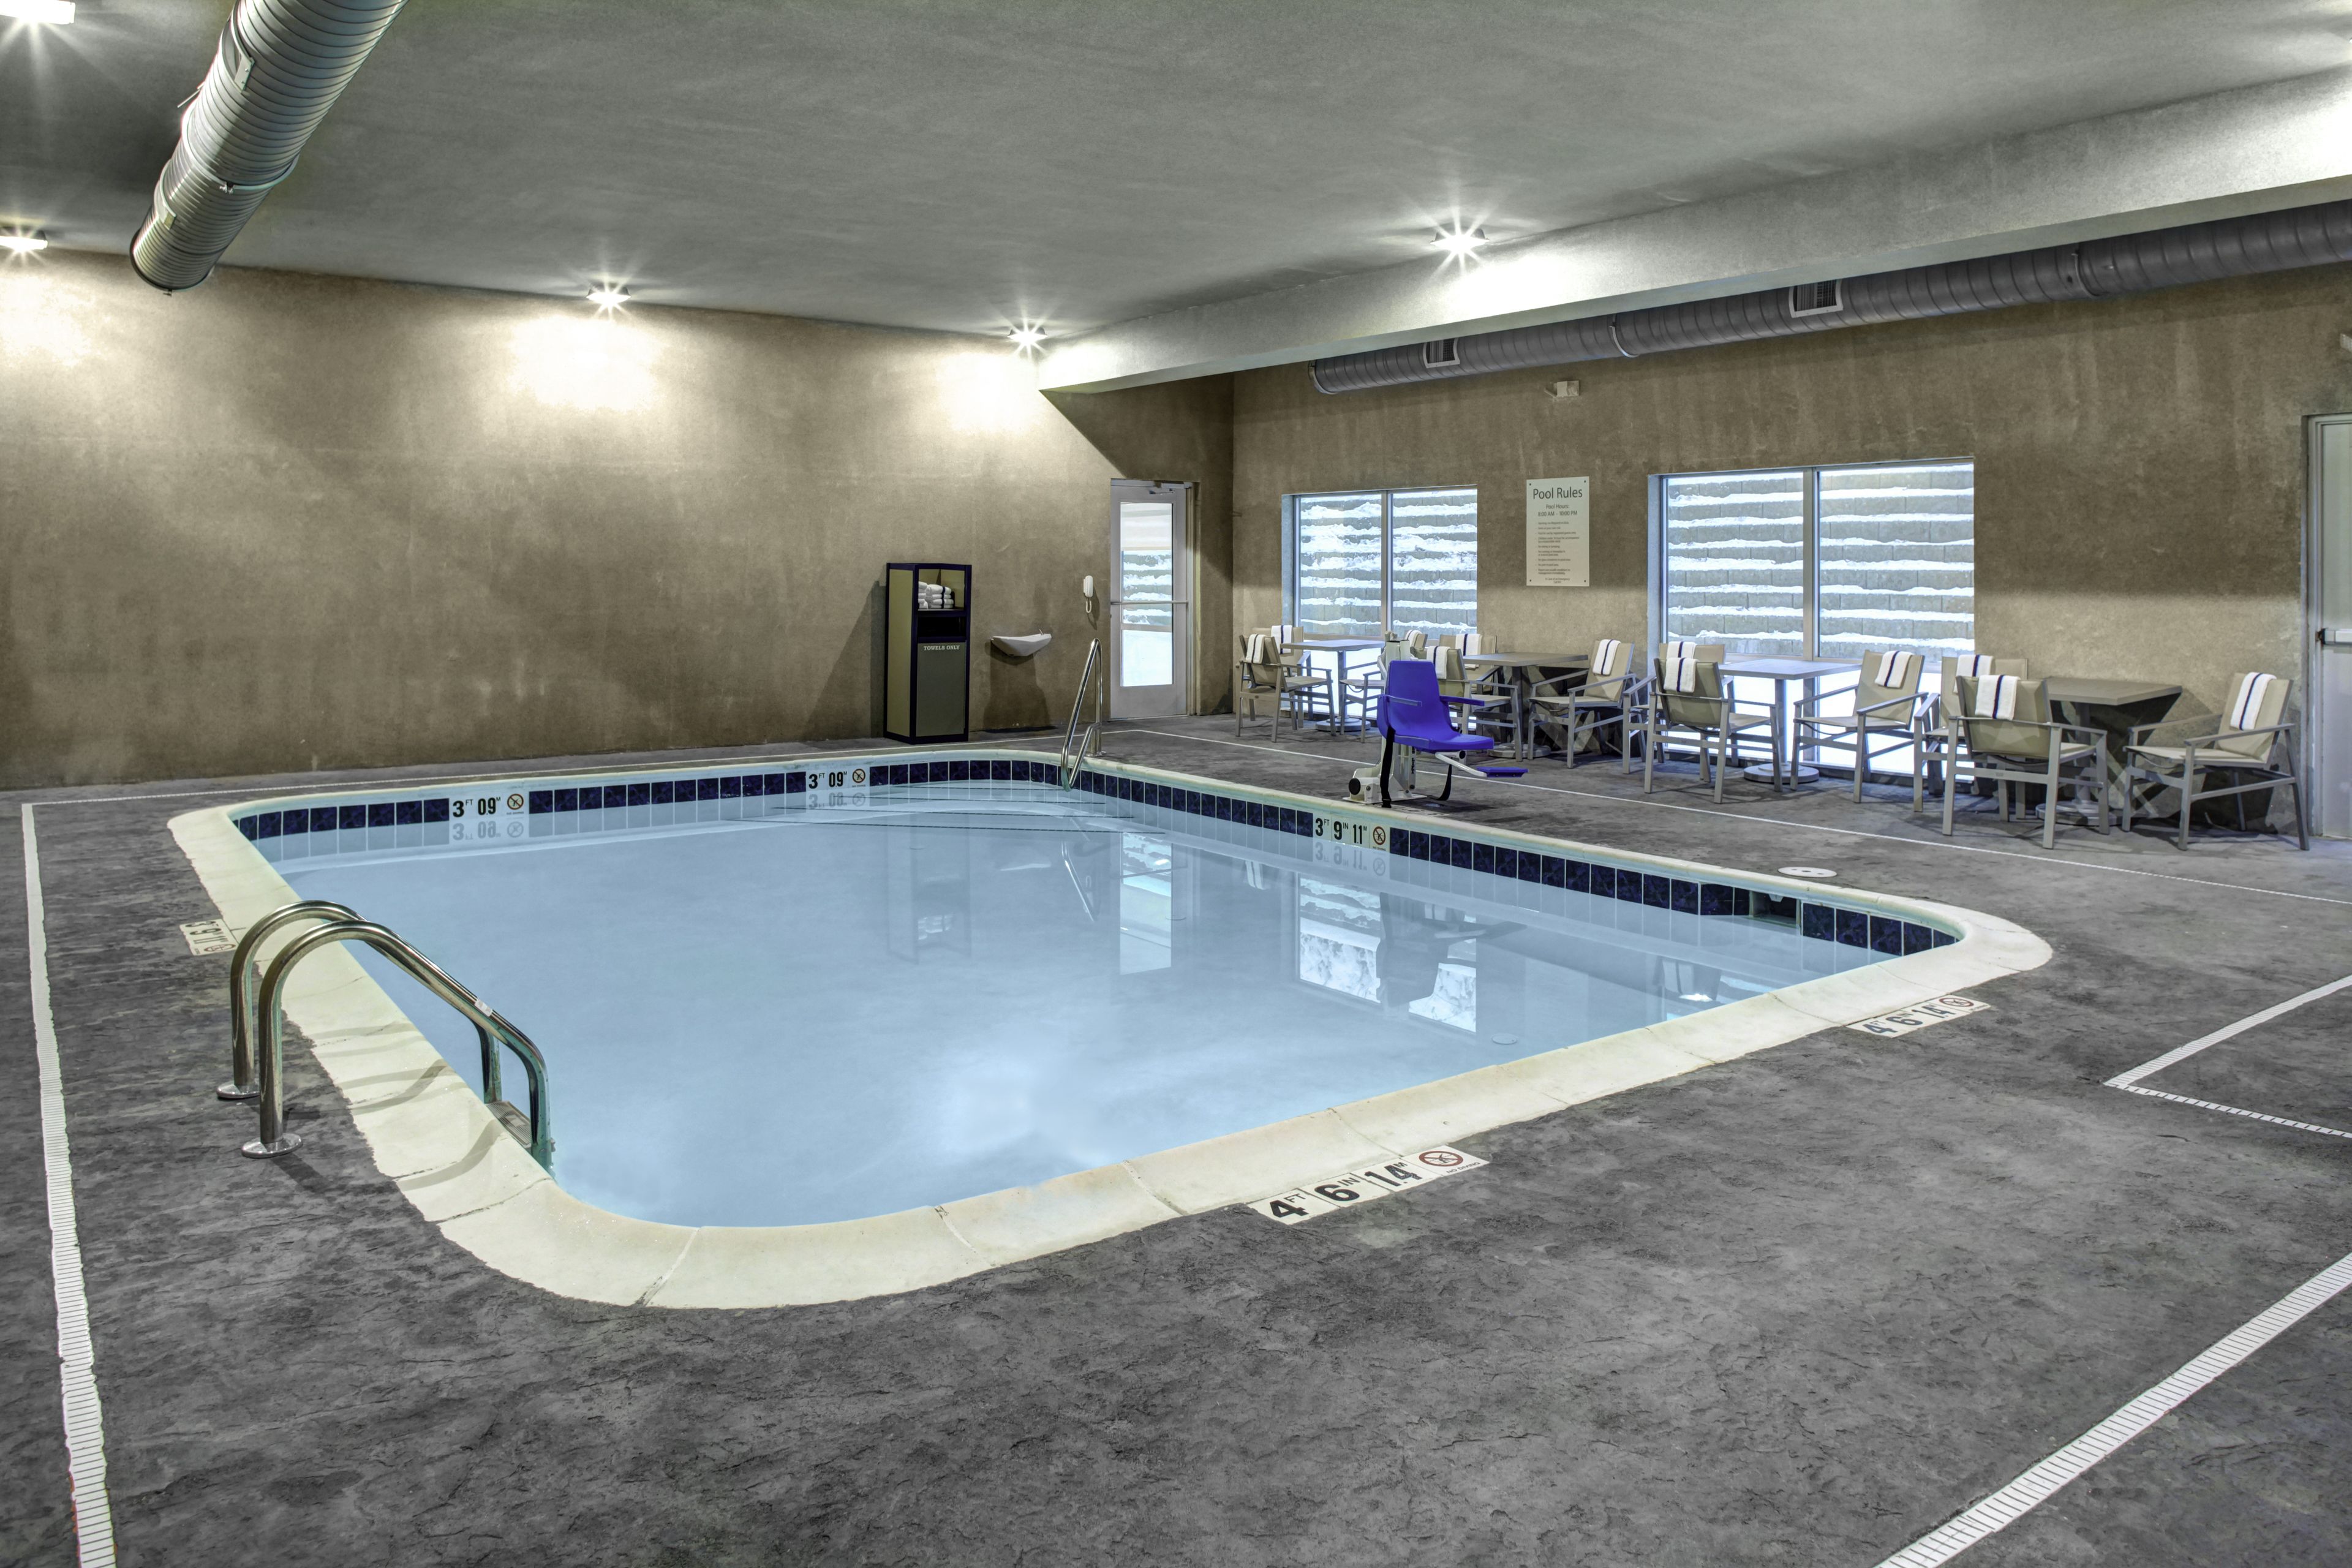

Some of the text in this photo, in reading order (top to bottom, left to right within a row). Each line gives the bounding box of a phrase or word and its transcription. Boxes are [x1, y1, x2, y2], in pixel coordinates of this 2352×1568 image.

[1533, 486, 1583, 499] Pool Rules
[809, 774, 818, 789] 3
[453, 801, 464, 818] 3
[1315, 818, 1323, 836] 3
[1333, 821, 1342, 840] 9
[1863, 1023, 1898, 1033] 4
[1885, 1016, 1923, 1025] 6
[1337, 1177, 1362, 1186] IN
[1283, 1193, 1306, 1203] FT
[1314, 1184, 1360, 1201] 6
[1270, 1199, 1310, 1218] 4
